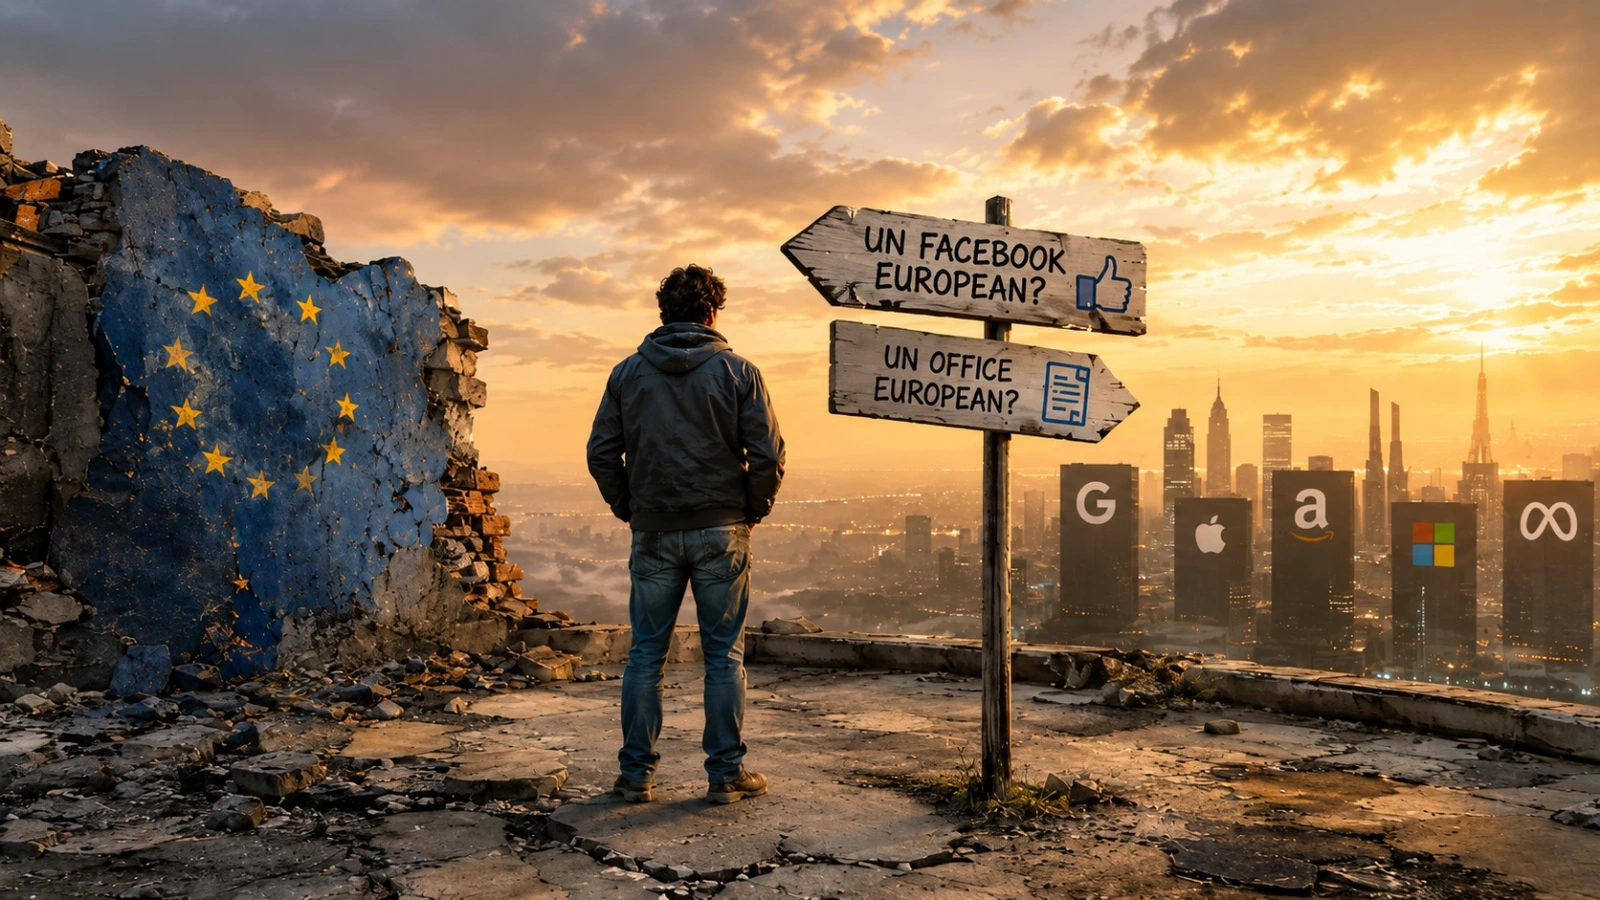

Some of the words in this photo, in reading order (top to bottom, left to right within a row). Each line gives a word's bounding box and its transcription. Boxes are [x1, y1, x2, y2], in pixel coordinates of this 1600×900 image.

[864, 226, 905, 256] UN
[920, 232, 1066, 275] FACEBOOK
[875, 262, 1046, 305] EUROPEAN?
[884, 344, 918, 371] UN
[929, 350, 1013, 382] OFFICE
[873, 376, 1020, 415] EUROPEAN?
[1076, 481, 1116, 525] G
[1294, 488, 1330, 530] a
